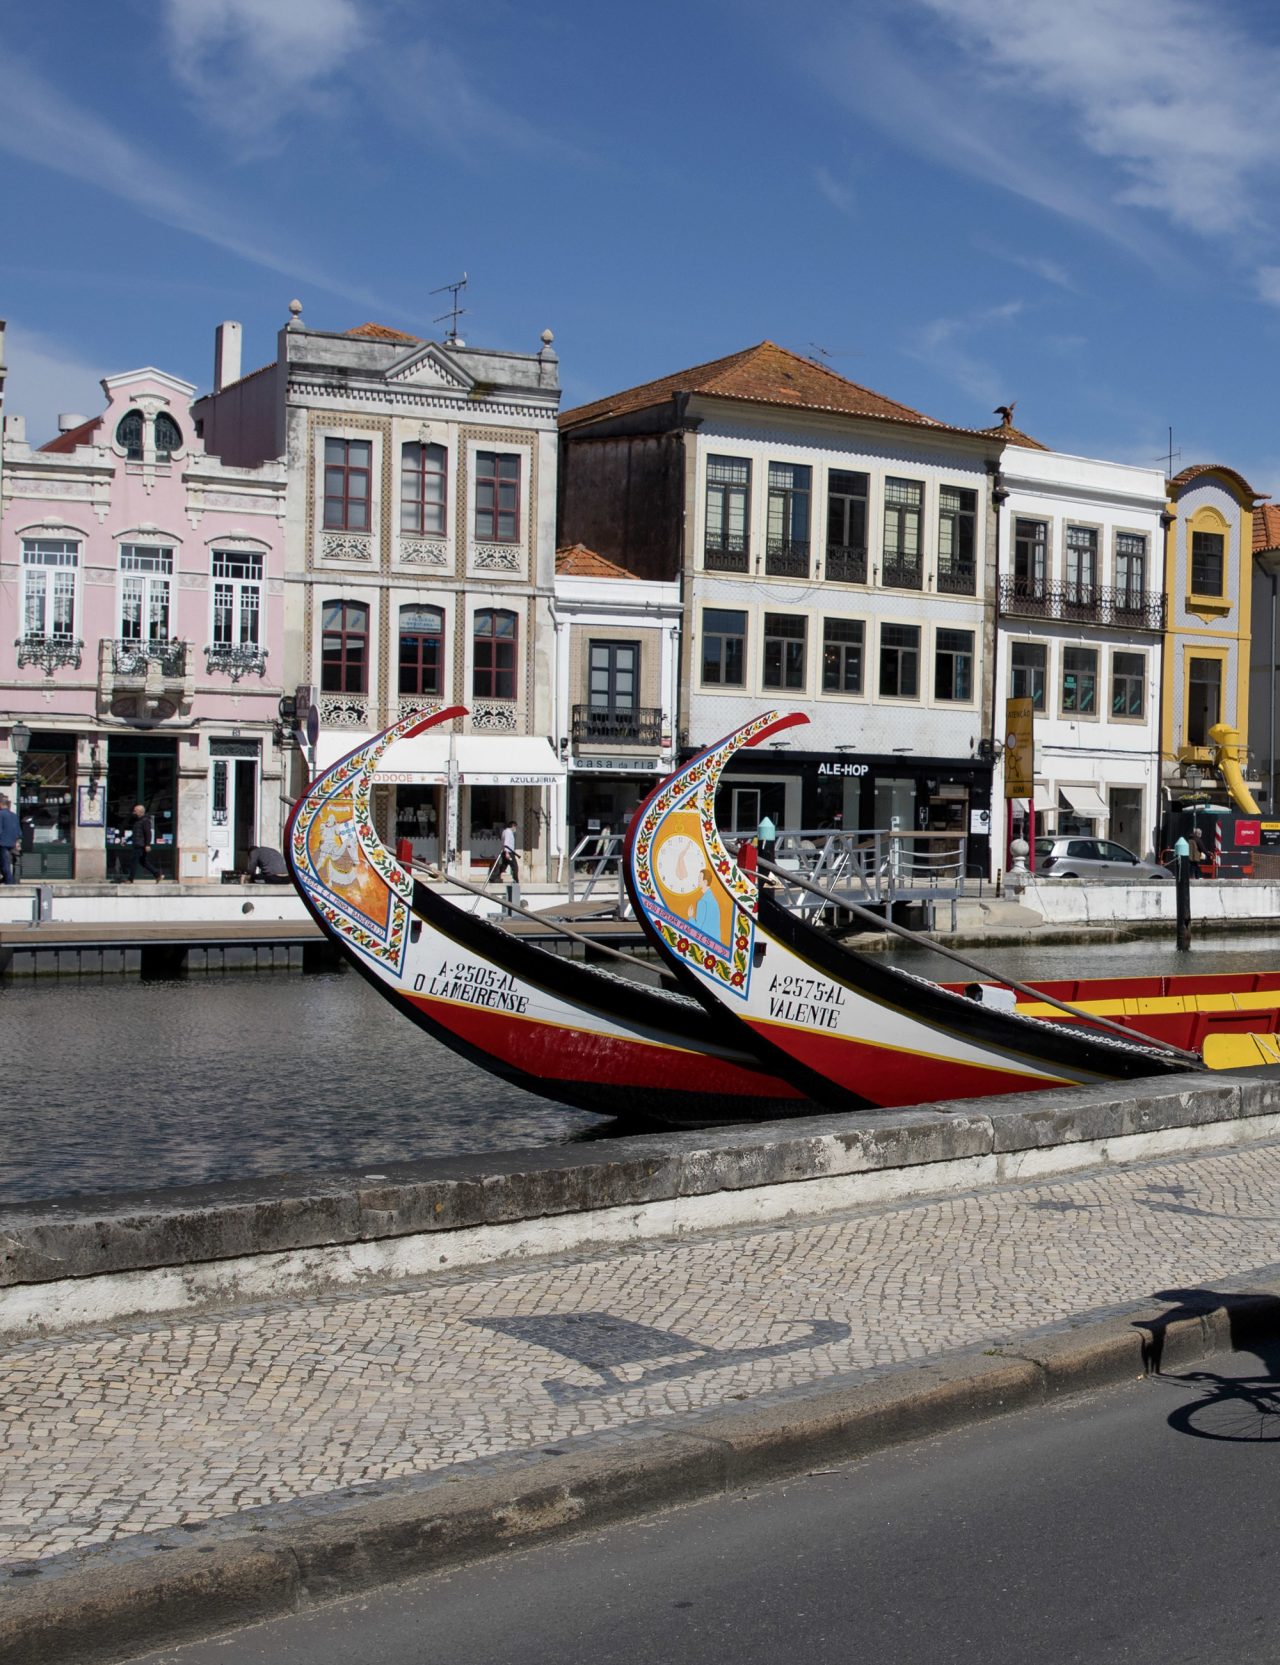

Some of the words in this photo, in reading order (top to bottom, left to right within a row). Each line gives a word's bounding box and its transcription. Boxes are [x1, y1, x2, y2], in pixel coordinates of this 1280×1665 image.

[576, 759, 613, 769] casa
[634, 761, 654, 770] ria
[817, 762, 869, 776] ALE-HOP
[413, 973, 426, 992] O
[428, 977, 530, 1014] LAMEIRENSE
[769, 997, 841, 1029] VALENTE
